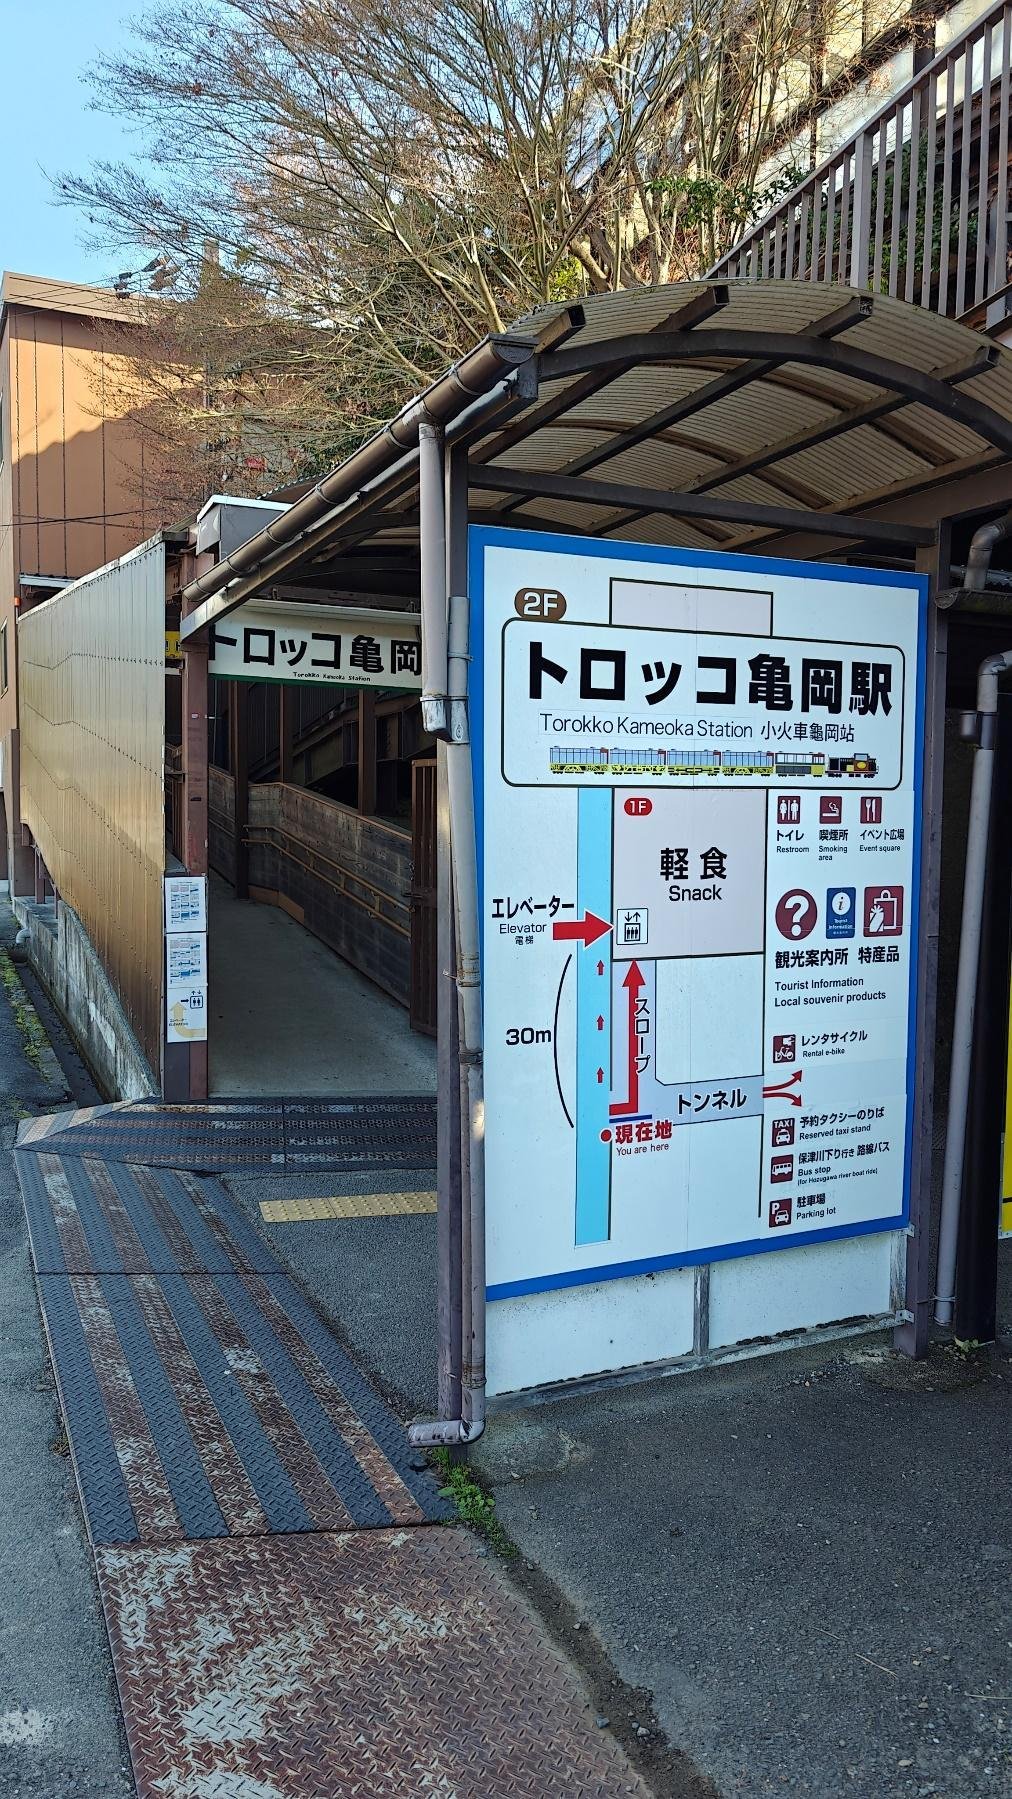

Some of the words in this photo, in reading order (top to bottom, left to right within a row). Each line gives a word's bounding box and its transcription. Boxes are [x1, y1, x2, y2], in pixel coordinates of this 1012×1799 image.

[523, 592, 559, 616] 2F
[529, 641, 893, 717] トロッコ亀岡駅
[540, 713, 613, 734] Torokko
[617, 717, 694, 737] Kameoka
[697, 720, 753, 739] Station
[761, 721, 855, 744] 小火車龜岡站
[629, 801, 647, 814] 1F
[776, 829, 805, 842] トイレ
[819, 829, 848, 842] 喫煙所
[859, 828, 905, 841] イベント広場
[818, 846, 848, 854] Smoking
[879, 846, 901, 854] square
[660, 847, 728, 881] 軽食
[668, 884, 722, 902] Snack
[491, 895, 575, 919] エレベーター
[499, 922, 547, 934] Elevator
[775, 948, 849, 970] 観光案内所
[858, 945, 900, 965] 特産品
[775, 979, 809, 992] Tourist
[811, 977, 864, 989] Information
[774, 996, 800, 1008] Local
[803, 994, 844, 1005] souvenir
[846, 990, 886, 1002] products
[505, 1028, 552, 1046] 30m
[634, 997, 651, 1076] スロープ
[801, 1030, 868, 1047] レンタサイクル
[802, 1048, 824, 1058] Rental
[826, 1048, 846, 1056] e-bike
[677, 1088, 748, 1114] トンネル
[774, 1119, 793, 1128] TAXI
[800, 1106, 885, 1128] 予約タクシーのりば
[615, 1120, 673, 1144] 現在地
[800, 1128, 834, 1140] Reserved
[835, 1127, 850, 1136] taxi
[850, 1124, 871, 1134] stand
[616, 1145, 632, 1156] You
[634, 1145, 648, 1154] are
[650, 1142, 669, 1152] here
[798, 1148, 855, 1164] 保津川下り行き
[857, 1142, 890, 1157] 路線バス
[798, 1168, 813, 1177] Bus
[814, 1166, 832, 1174] stop
[796, 1192, 826, 1208] 駐車場
[796, 1210, 825, 1220] Parking
[826, 1206, 836, 1215] lot
